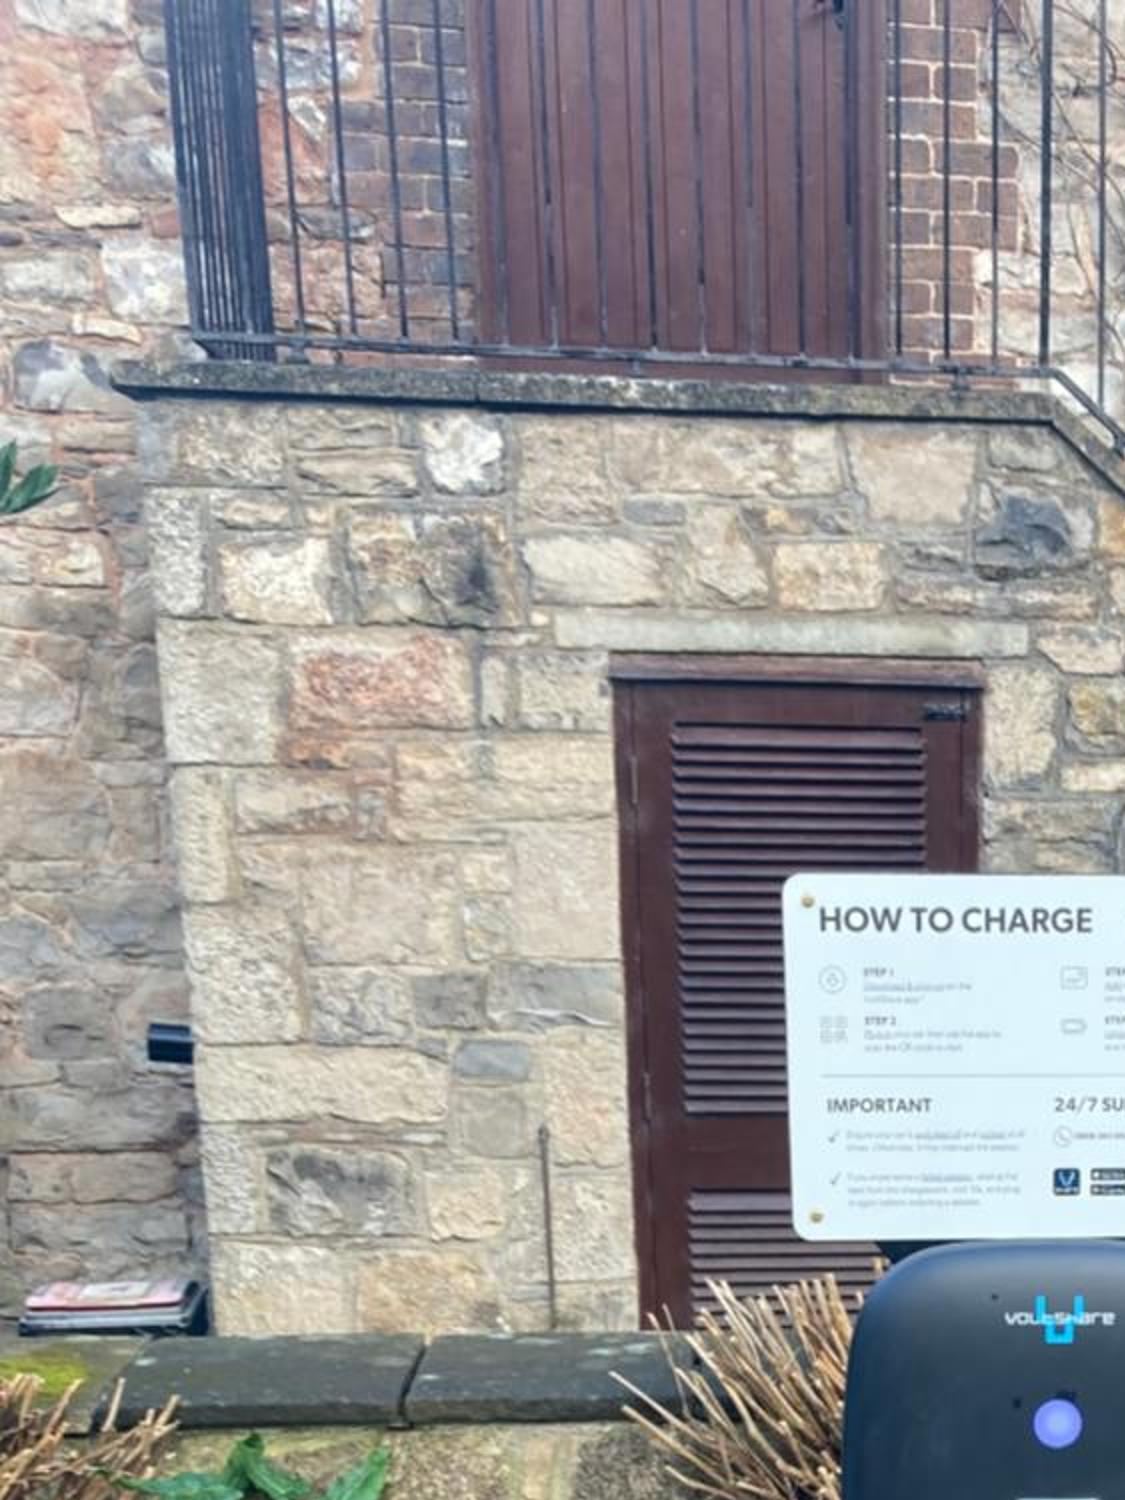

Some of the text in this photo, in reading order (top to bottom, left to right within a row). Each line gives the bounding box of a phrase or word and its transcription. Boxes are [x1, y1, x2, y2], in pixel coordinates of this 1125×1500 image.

[819, 906, 1093, 933] HOW TO CHARGE
[863, 967, 887, 977] STEP
[864, 1015, 888, 1026] STEP
[827, 1098, 932, 1114] IMPORTANT
[1055, 1097, 1097, 1114] 24/7
